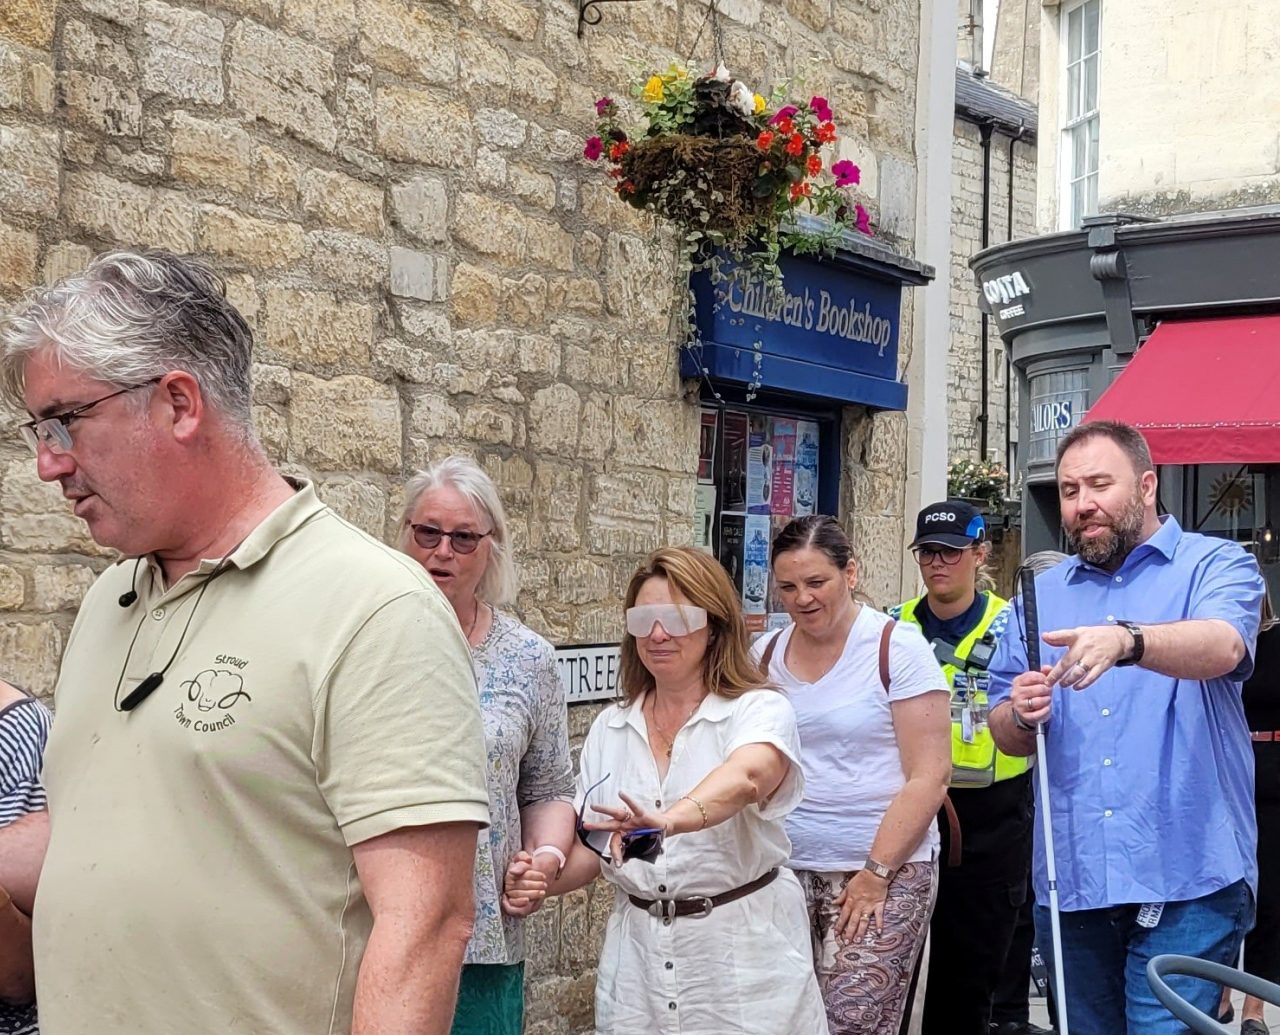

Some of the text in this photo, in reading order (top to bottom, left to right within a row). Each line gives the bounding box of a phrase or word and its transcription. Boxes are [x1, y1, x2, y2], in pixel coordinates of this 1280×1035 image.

[983, 271, 1030, 304] COSTA
[816, 288, 891, 357] Bookshop
[1032, 401, 1071, 433] AILORS
[924, 512, 956, 524] PCSO
[214, 654, 249, 670] Stroud
[558, 654, 623, 695] TREE
[174, 702, 236, 733] Town Council
[1137, 903, 1152, 924] FRO
